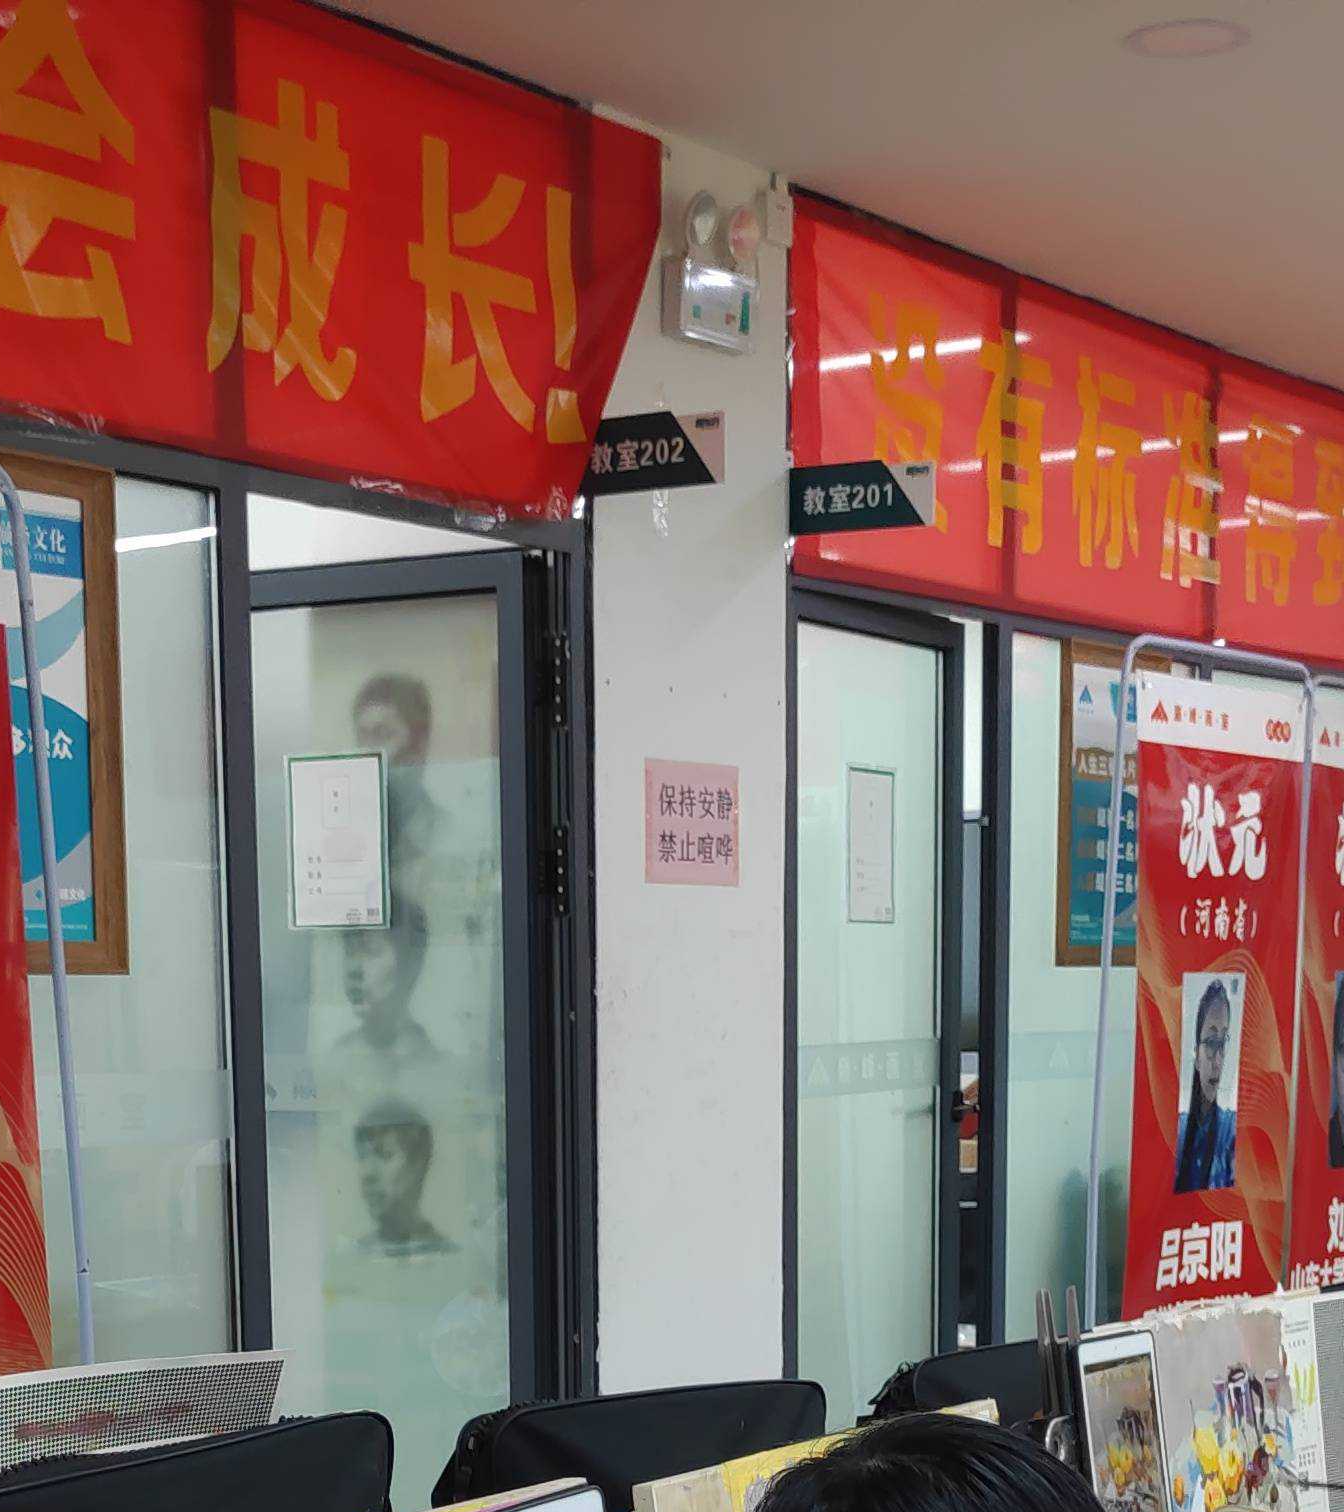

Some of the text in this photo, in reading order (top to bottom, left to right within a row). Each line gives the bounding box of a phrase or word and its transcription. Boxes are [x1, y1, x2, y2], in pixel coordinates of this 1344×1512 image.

[590, 437, 686, 475] 教室202
[802, 482, 894, 516] 教室201
[658, 783, 734, 820] 保持安静
[658, 829, 734, 866] 禁止喧哗
[1178, 782, 1267, 881] 状元
[1155, 1220, 1244, 1292] 吕京阳
